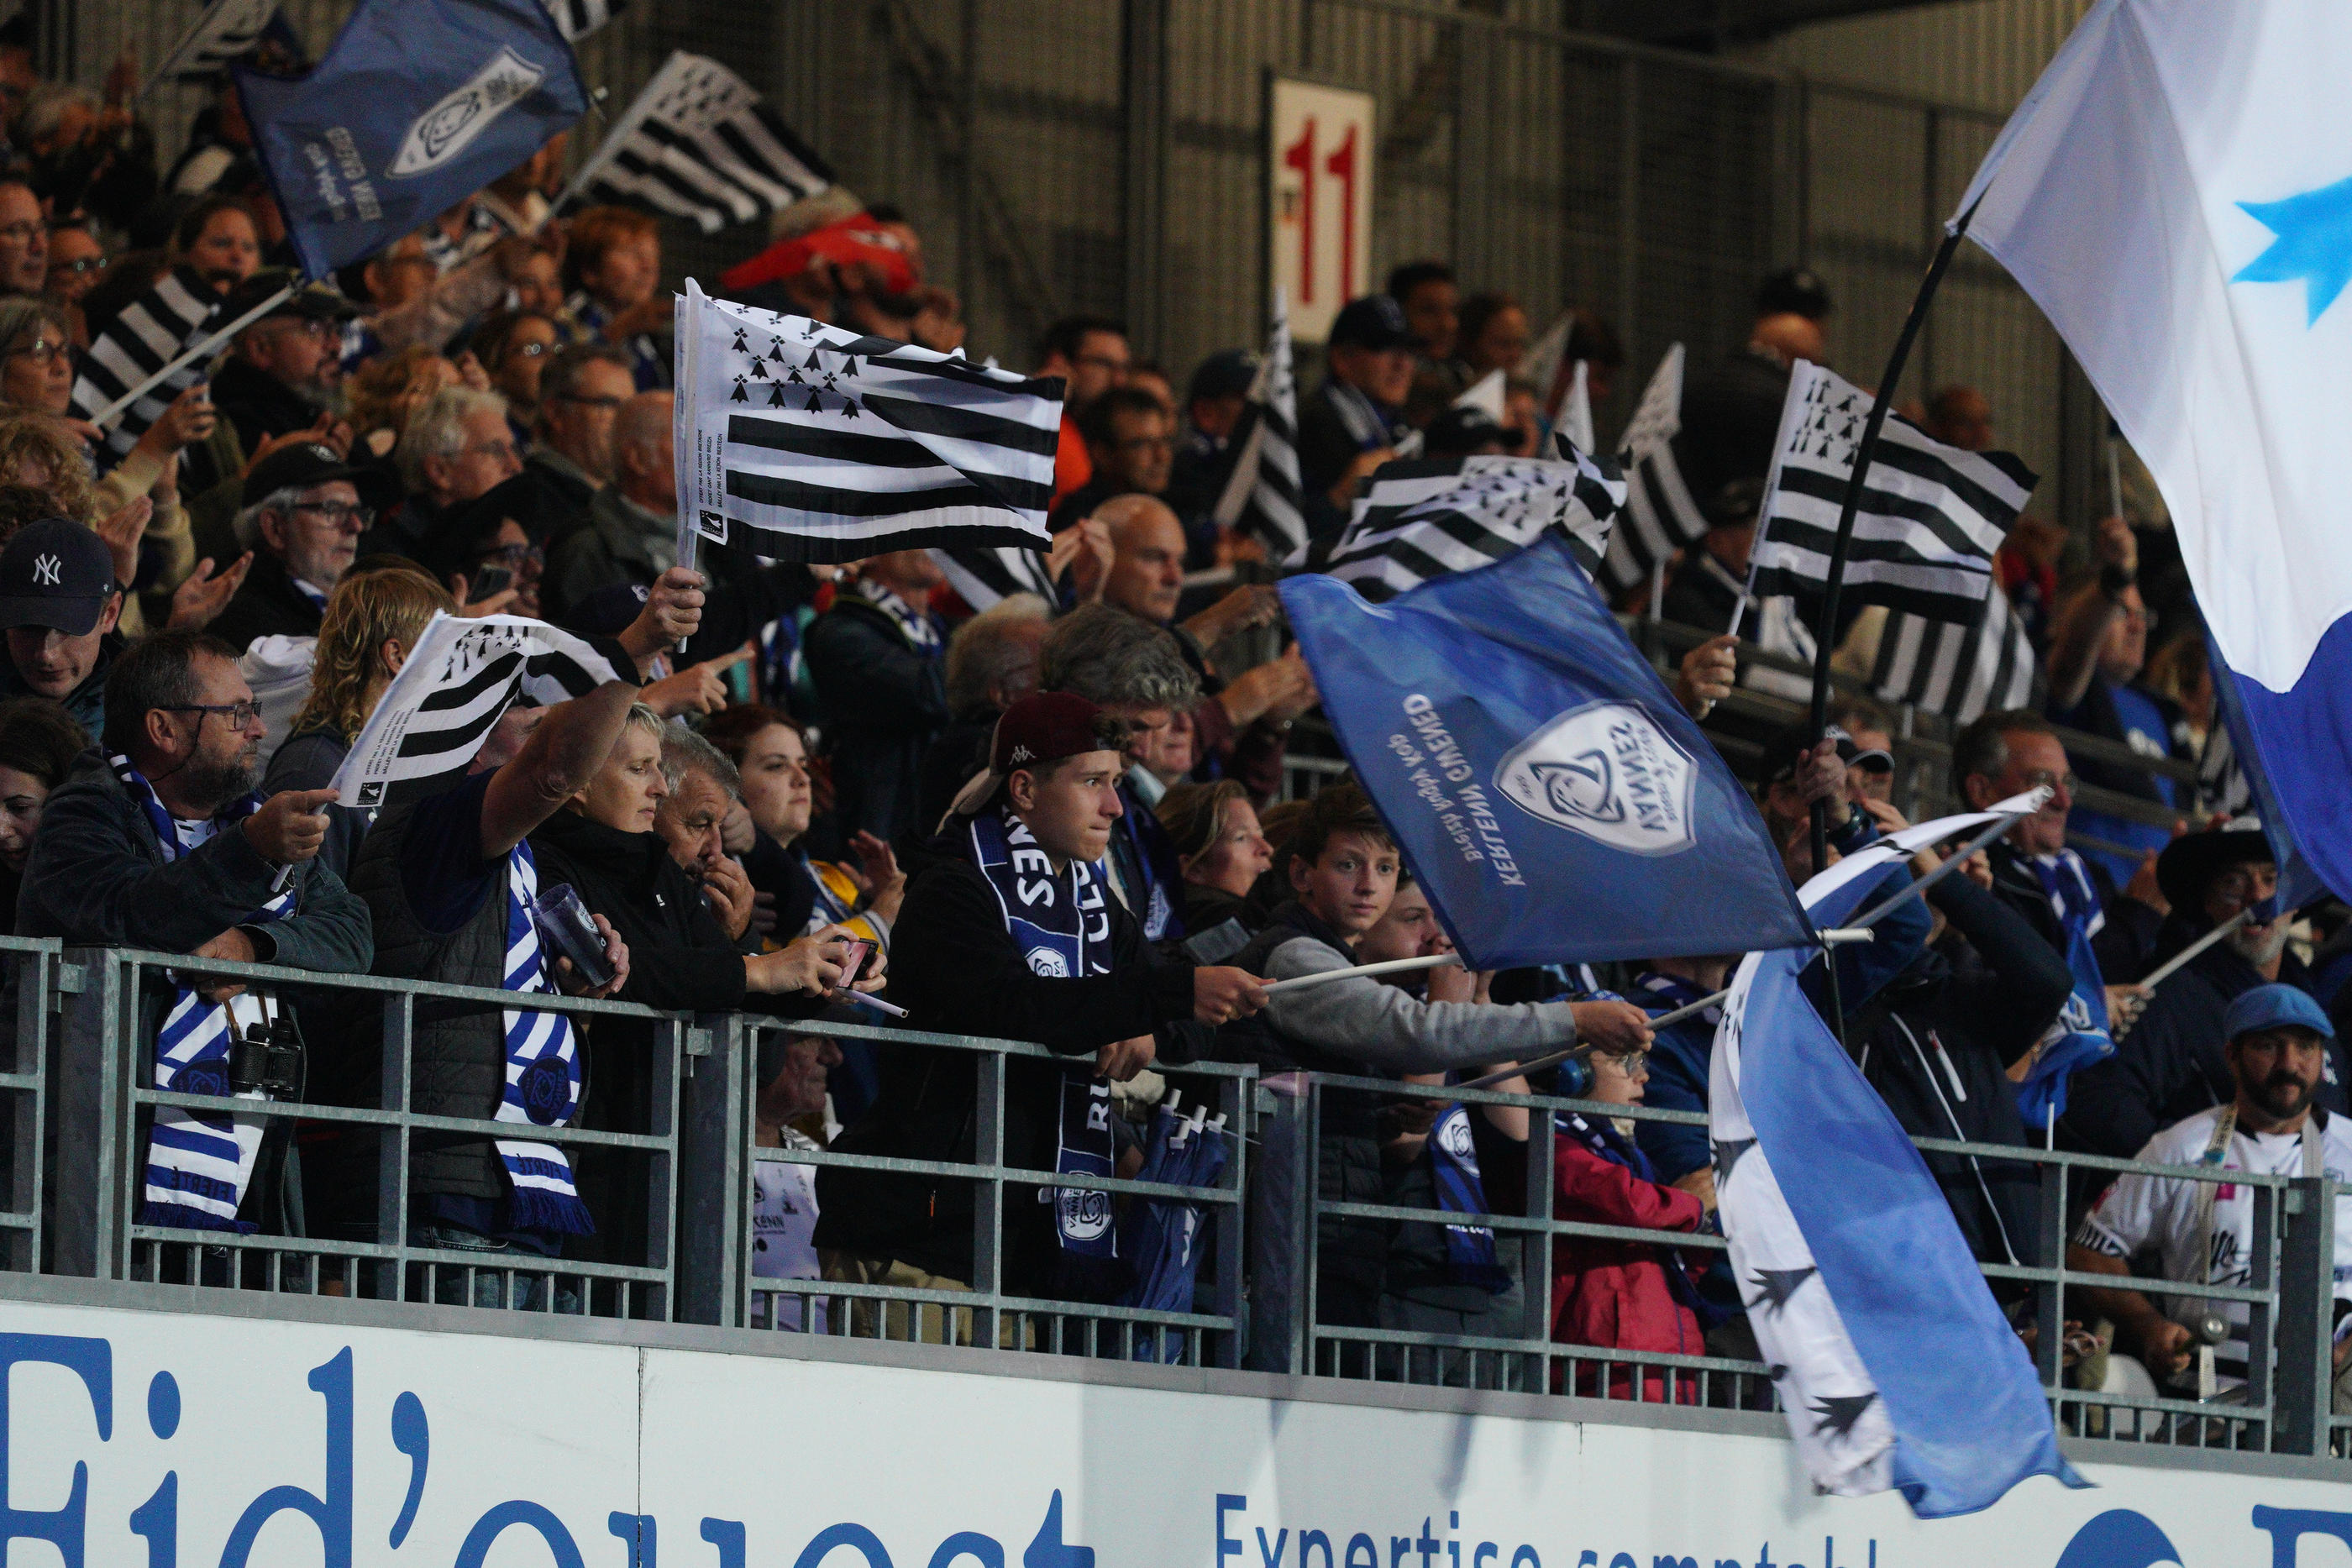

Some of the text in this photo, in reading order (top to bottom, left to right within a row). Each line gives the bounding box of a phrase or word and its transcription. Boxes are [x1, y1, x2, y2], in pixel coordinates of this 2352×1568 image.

[1284, 114, 1357, 307] 11
[32, 553, 62, 585] NY
[1069, 1188, 1081, 1229] VANNE
